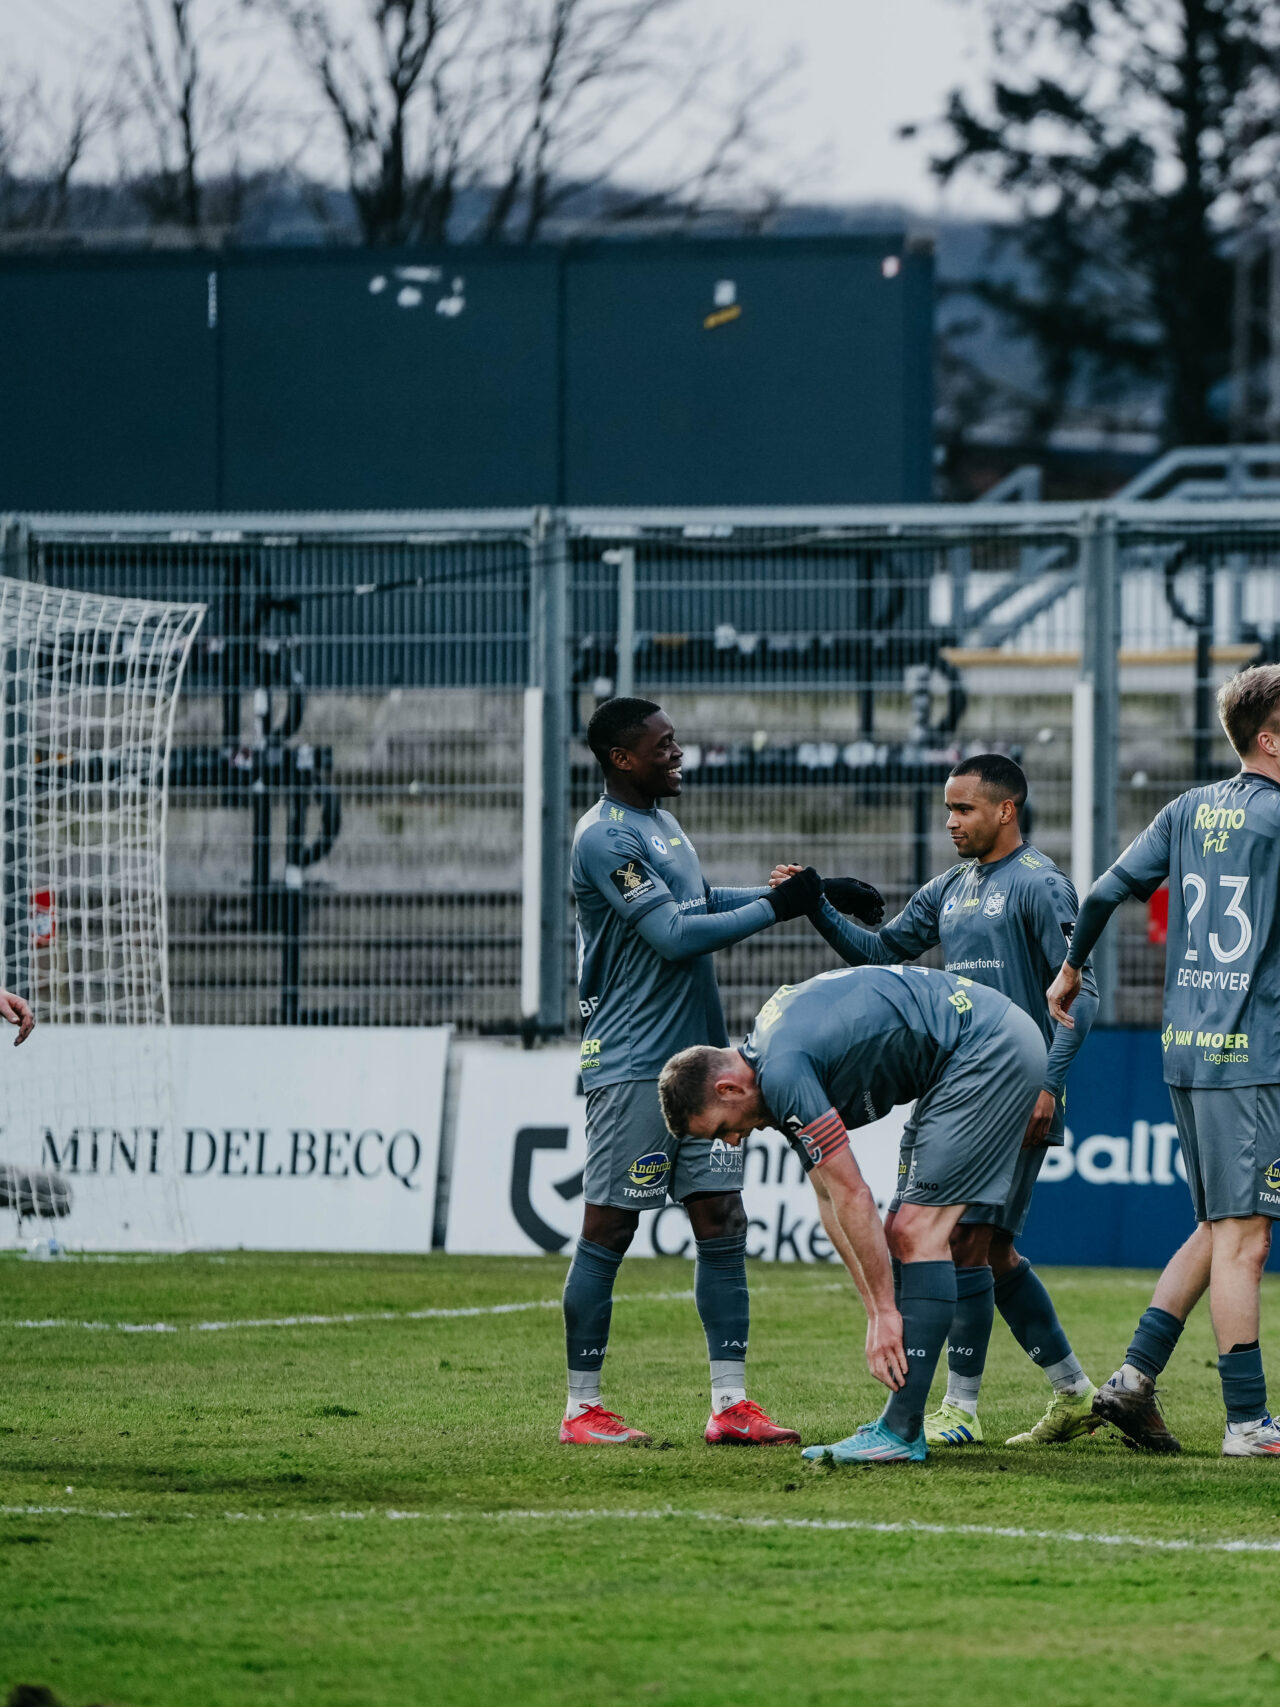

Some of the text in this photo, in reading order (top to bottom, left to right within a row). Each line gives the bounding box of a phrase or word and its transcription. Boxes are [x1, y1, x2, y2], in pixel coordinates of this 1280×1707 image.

[1194, 802, 1246, 831] Remo
[1181, 872, 1253, 964] 23
[1174, 1030, 1250, 1050] VAN MOER
[1203, 1050, 1250, 1065] Logistics
[40, 1126, 421, 1189] MINI DELBECQ
[623, 1186, 669, 1199] TRANSPORT
[915, 1180, 939, 1192] JAKO
[906, 1347, 927, 1357] KO
[945, 1345, 974, 1357] AKO
